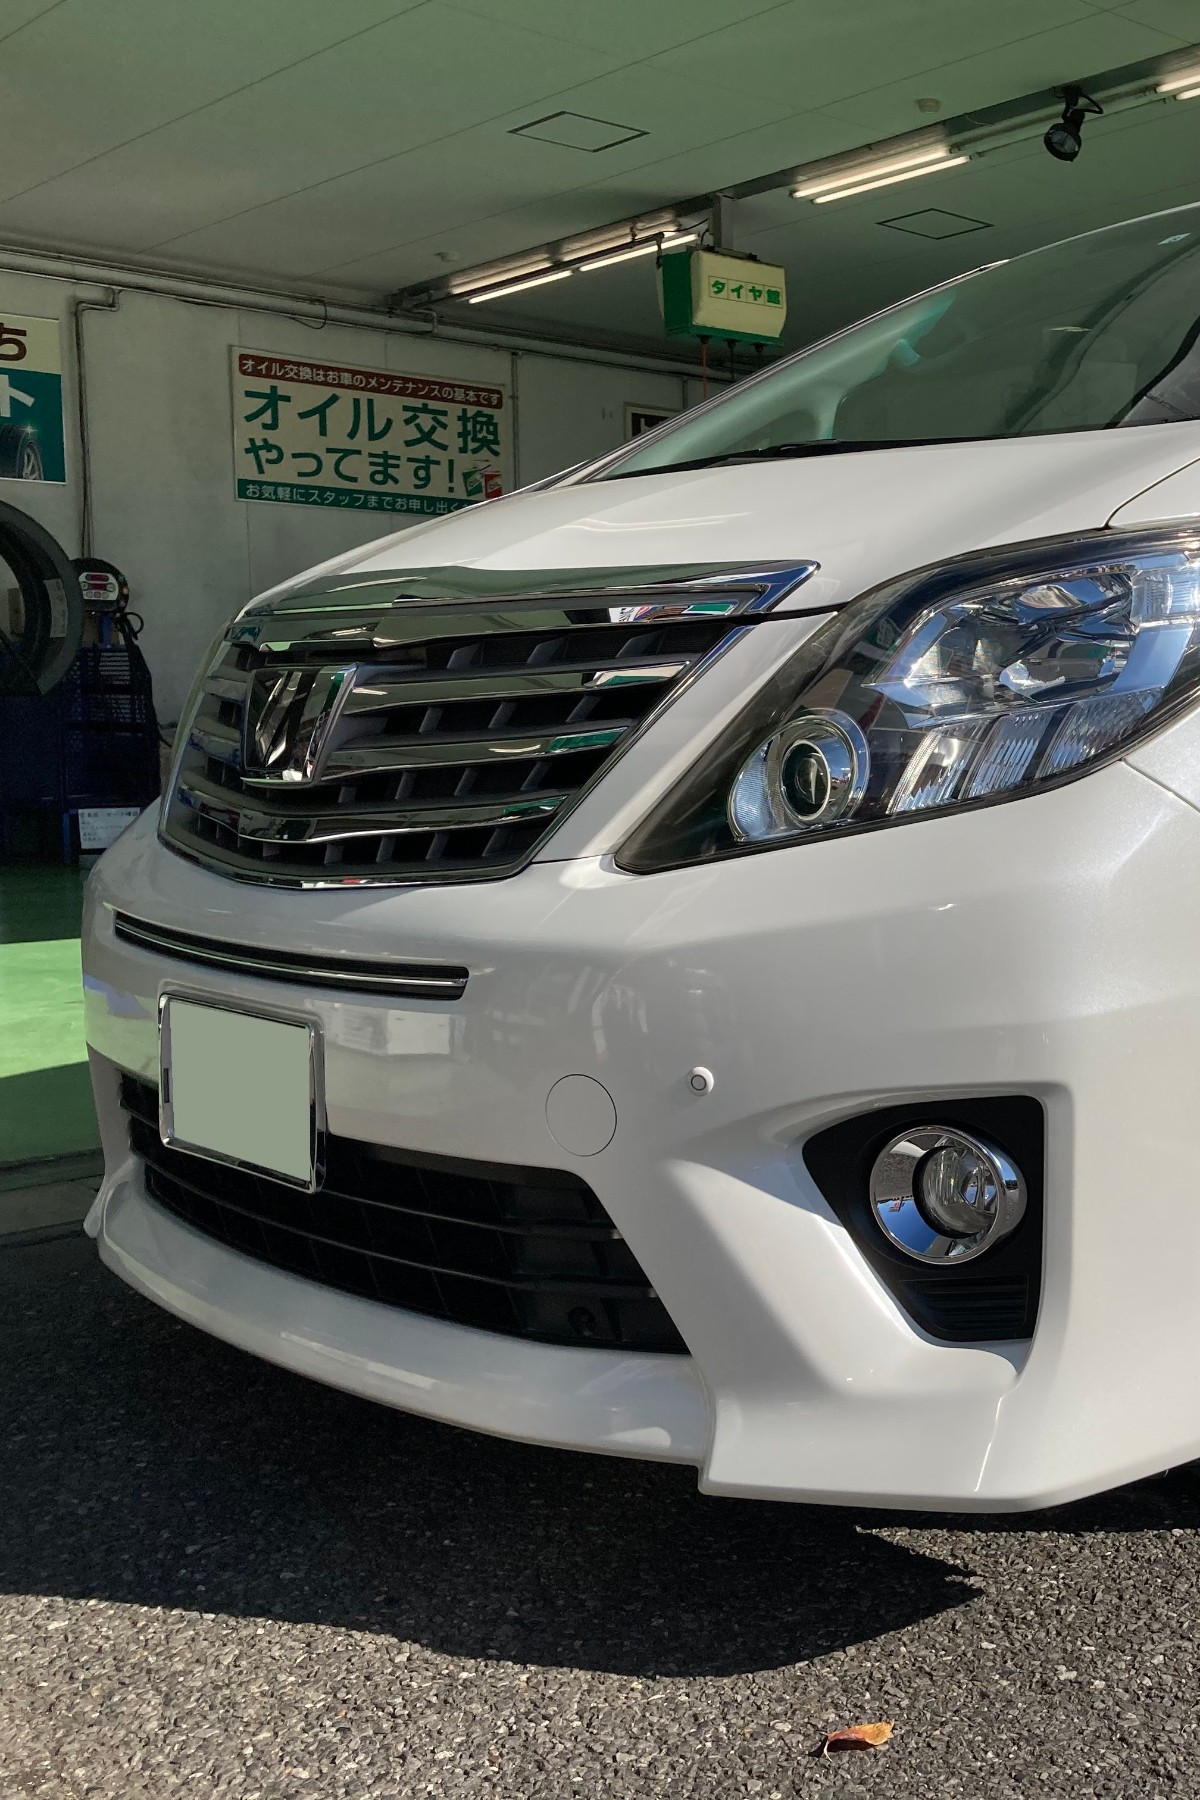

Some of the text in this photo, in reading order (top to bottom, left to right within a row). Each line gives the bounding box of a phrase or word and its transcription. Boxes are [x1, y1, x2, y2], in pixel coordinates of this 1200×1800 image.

[242, 359, 500, 405] オイル交換はお車のメンテナンスの基本です
[244, 385, 500, 456] オイル交換
